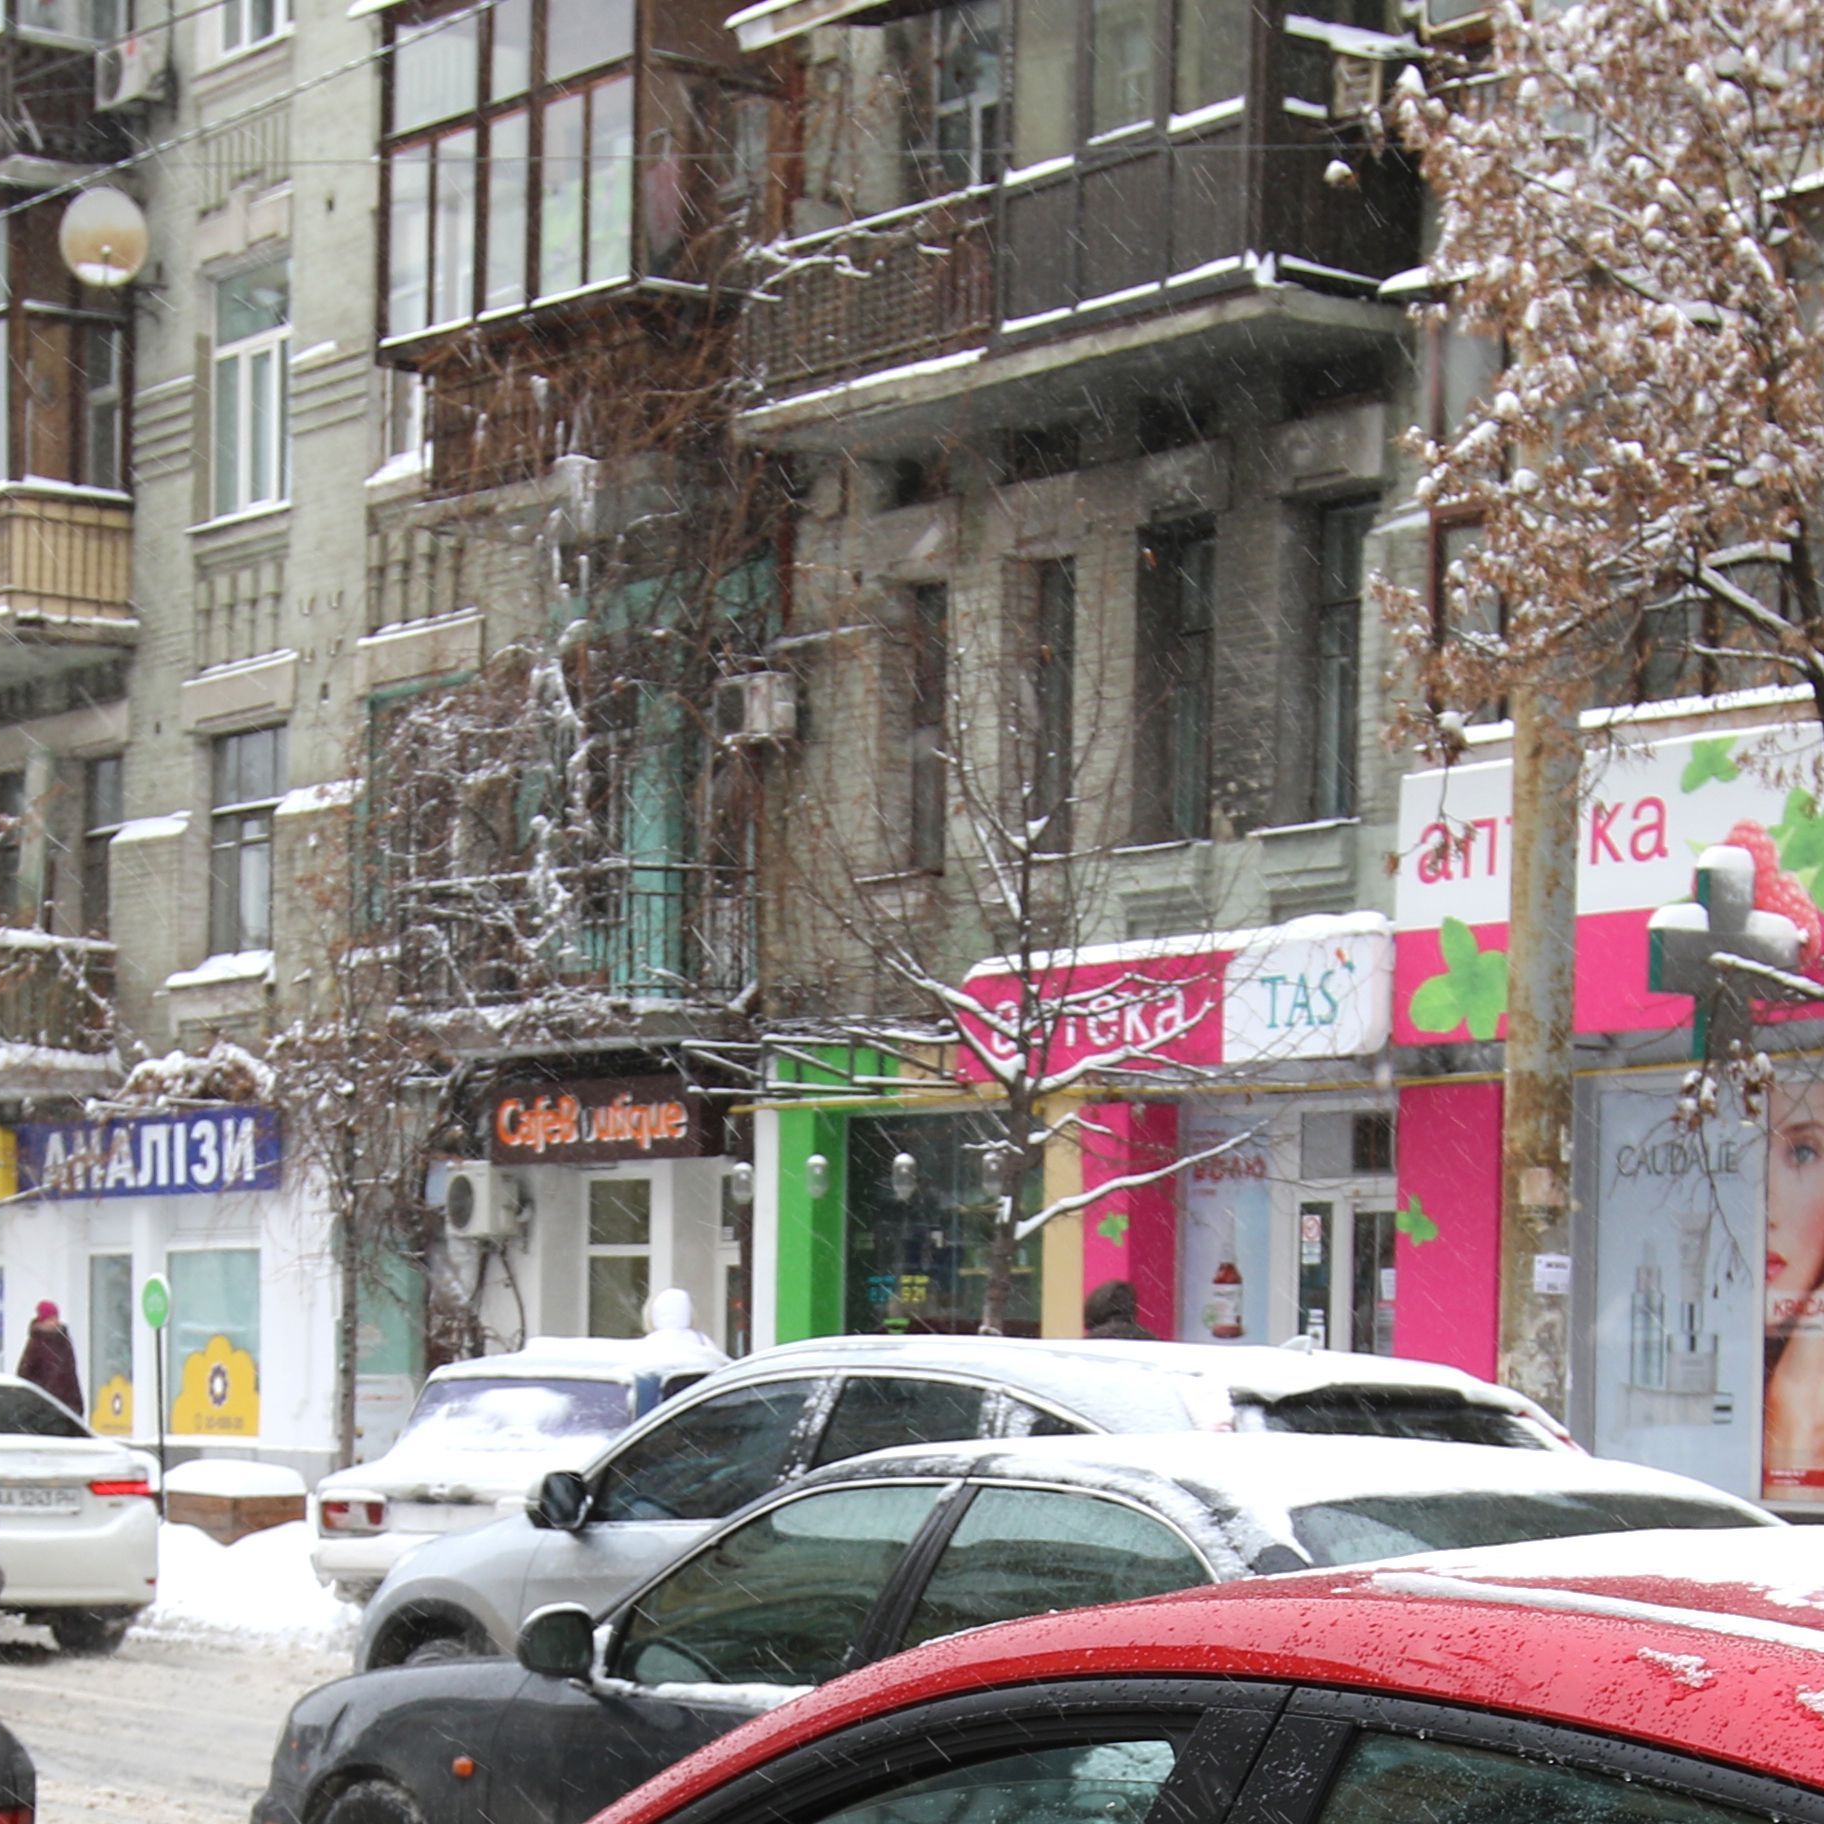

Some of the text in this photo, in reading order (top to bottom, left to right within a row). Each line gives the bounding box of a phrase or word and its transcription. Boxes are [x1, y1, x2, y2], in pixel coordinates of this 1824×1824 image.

[1417, 795, 1669, 884] апка
[1260, 968, 1340, 1029] TAS
[43, 1116, 256, 1191] АНАЛІЗИ
